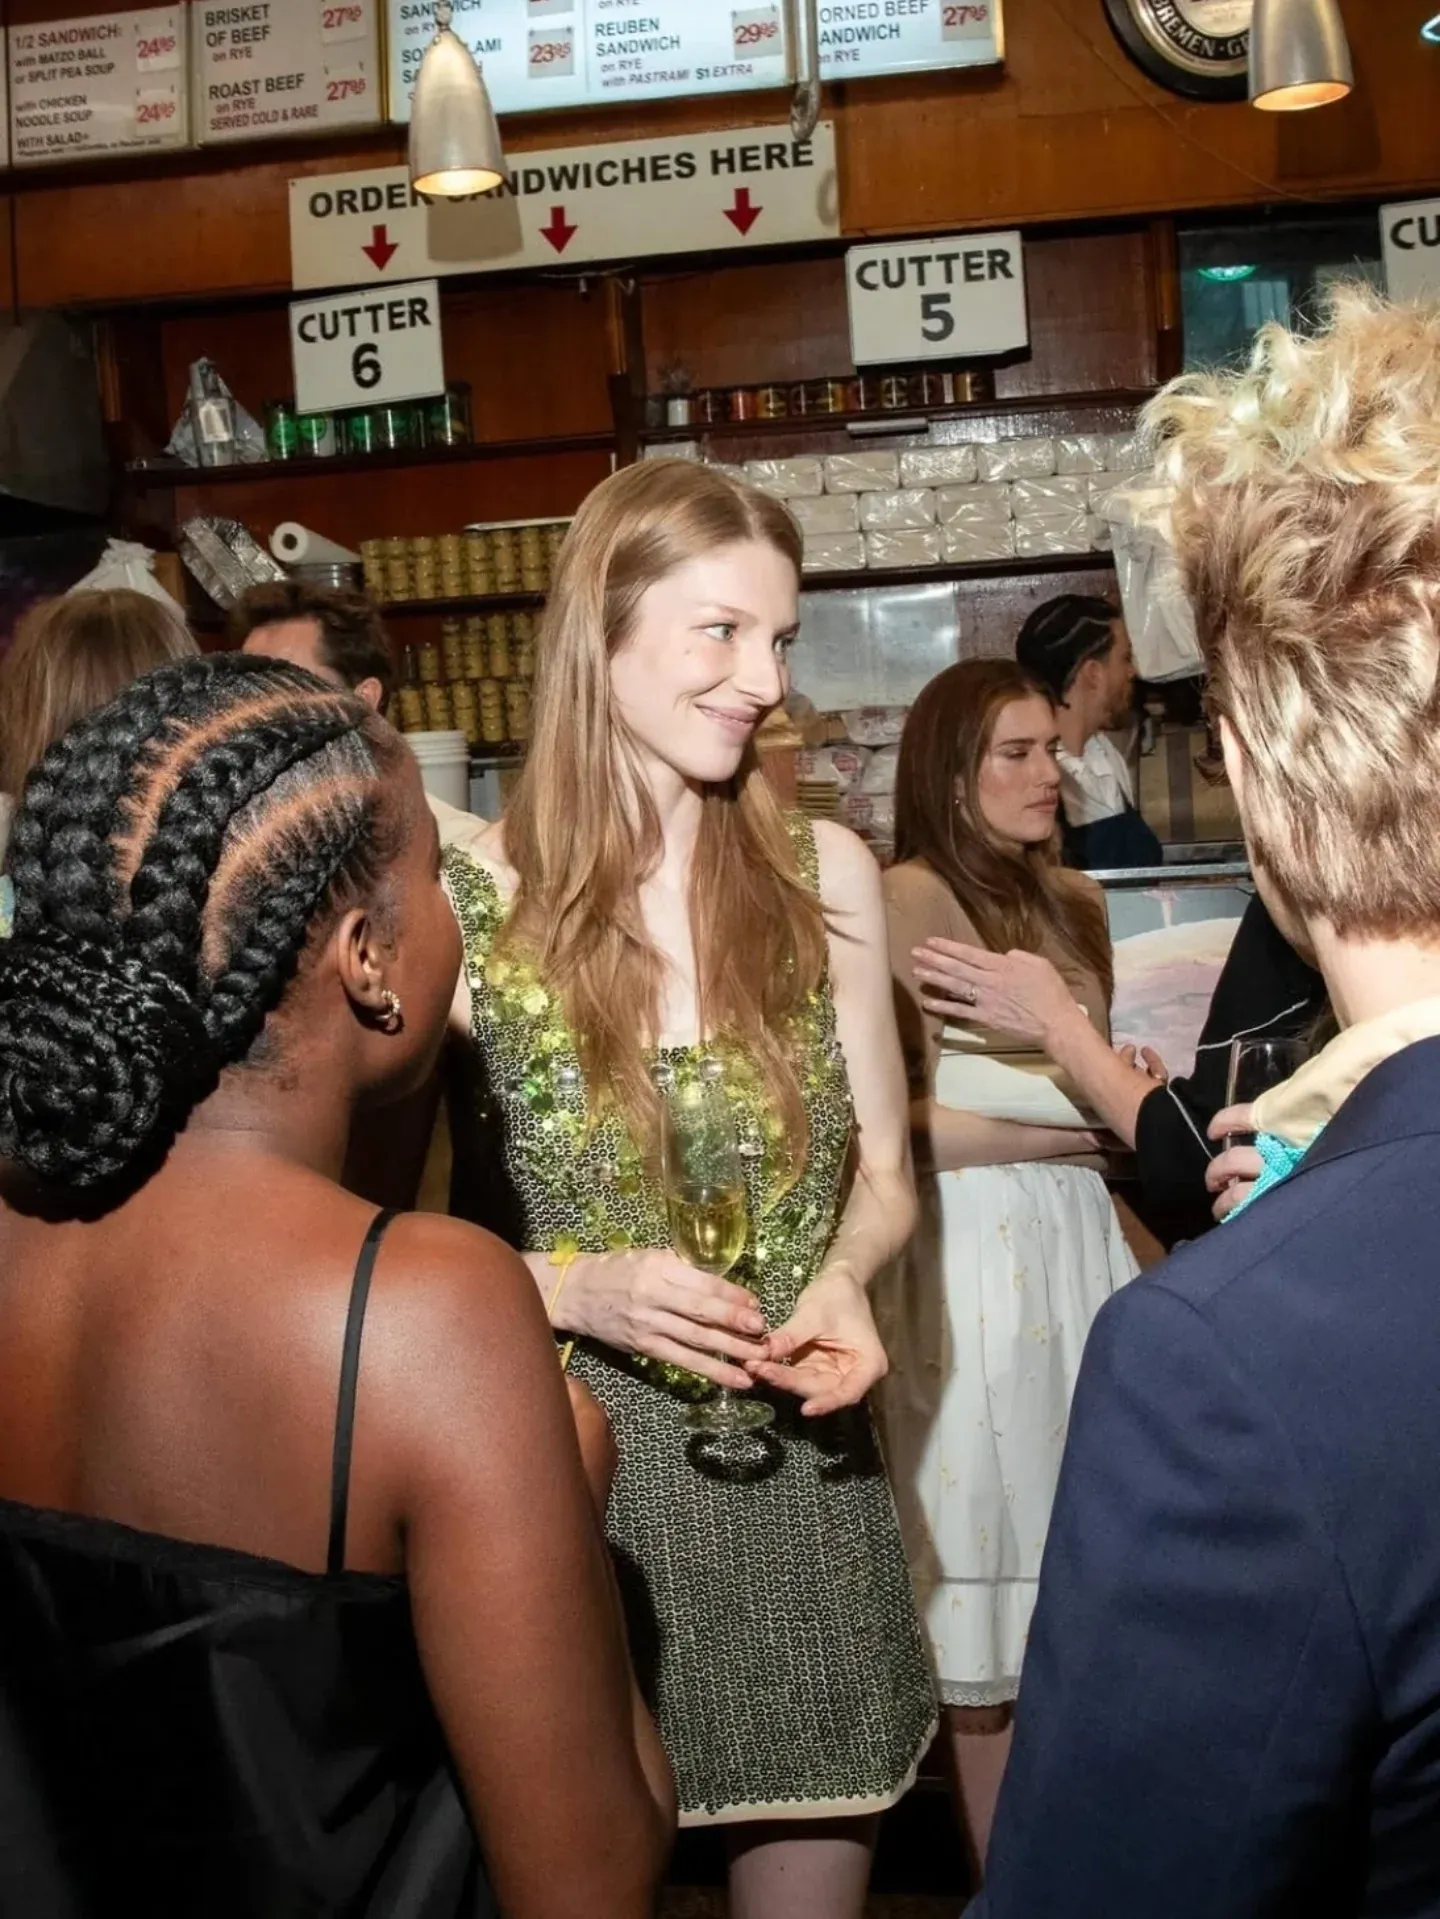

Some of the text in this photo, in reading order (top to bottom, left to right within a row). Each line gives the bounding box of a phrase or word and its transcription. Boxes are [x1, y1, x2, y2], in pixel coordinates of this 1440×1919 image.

[205, 4, 270, 26] BRISKET
[400, 0, 481, 19] SANICH
[820, 1, 929, 24] ORNED BEEF
[206, 25, 271, 47] OF BEEF
[595, 18, 660, 37] REUBEN
[819, 23, 900, 46] ANDWICH
[15, 35, 34, 50] 1/2
[474, 38, 502, 54] AMI
[596, 35, 681, 57] SANDWICH
[15, 47, 106, 67] with MATZO BALL
[212, 47, 252, 62] on RYE
[601, 58, 642, 72] on RYE
[834, 48, 860, 63] RYE
[28, 68, 57, 82] SPLIT
[60, 65, 82, 79] PEA
[85, 62, 115, 76] SOUP
[602, 77, 626, 88] with
[629, 69, 690, 85] PASTRAMI
[712, 64, 753, 78] EXTRA
[208, 73, 305, 99] ROAST BEEF
[39, 95, 87, 110] CHICKEN
[215, 98, 255, 113] on RYE
[16, 109, 94, 127] NOODLE SOUP
[210, 104, 318, 130] SERVED COLD & RARE
[17, 136, 43, 149] WITH
[447, 151, 697, 202] NDWICHES
[710, 140, 813, 175] HERE
[855, 248, 1014, 291] CUTTER
[298, 297, 431, 343] CUTTER
[920, 292, 955, 341] 5
[351, 344, 382, 388] 6
